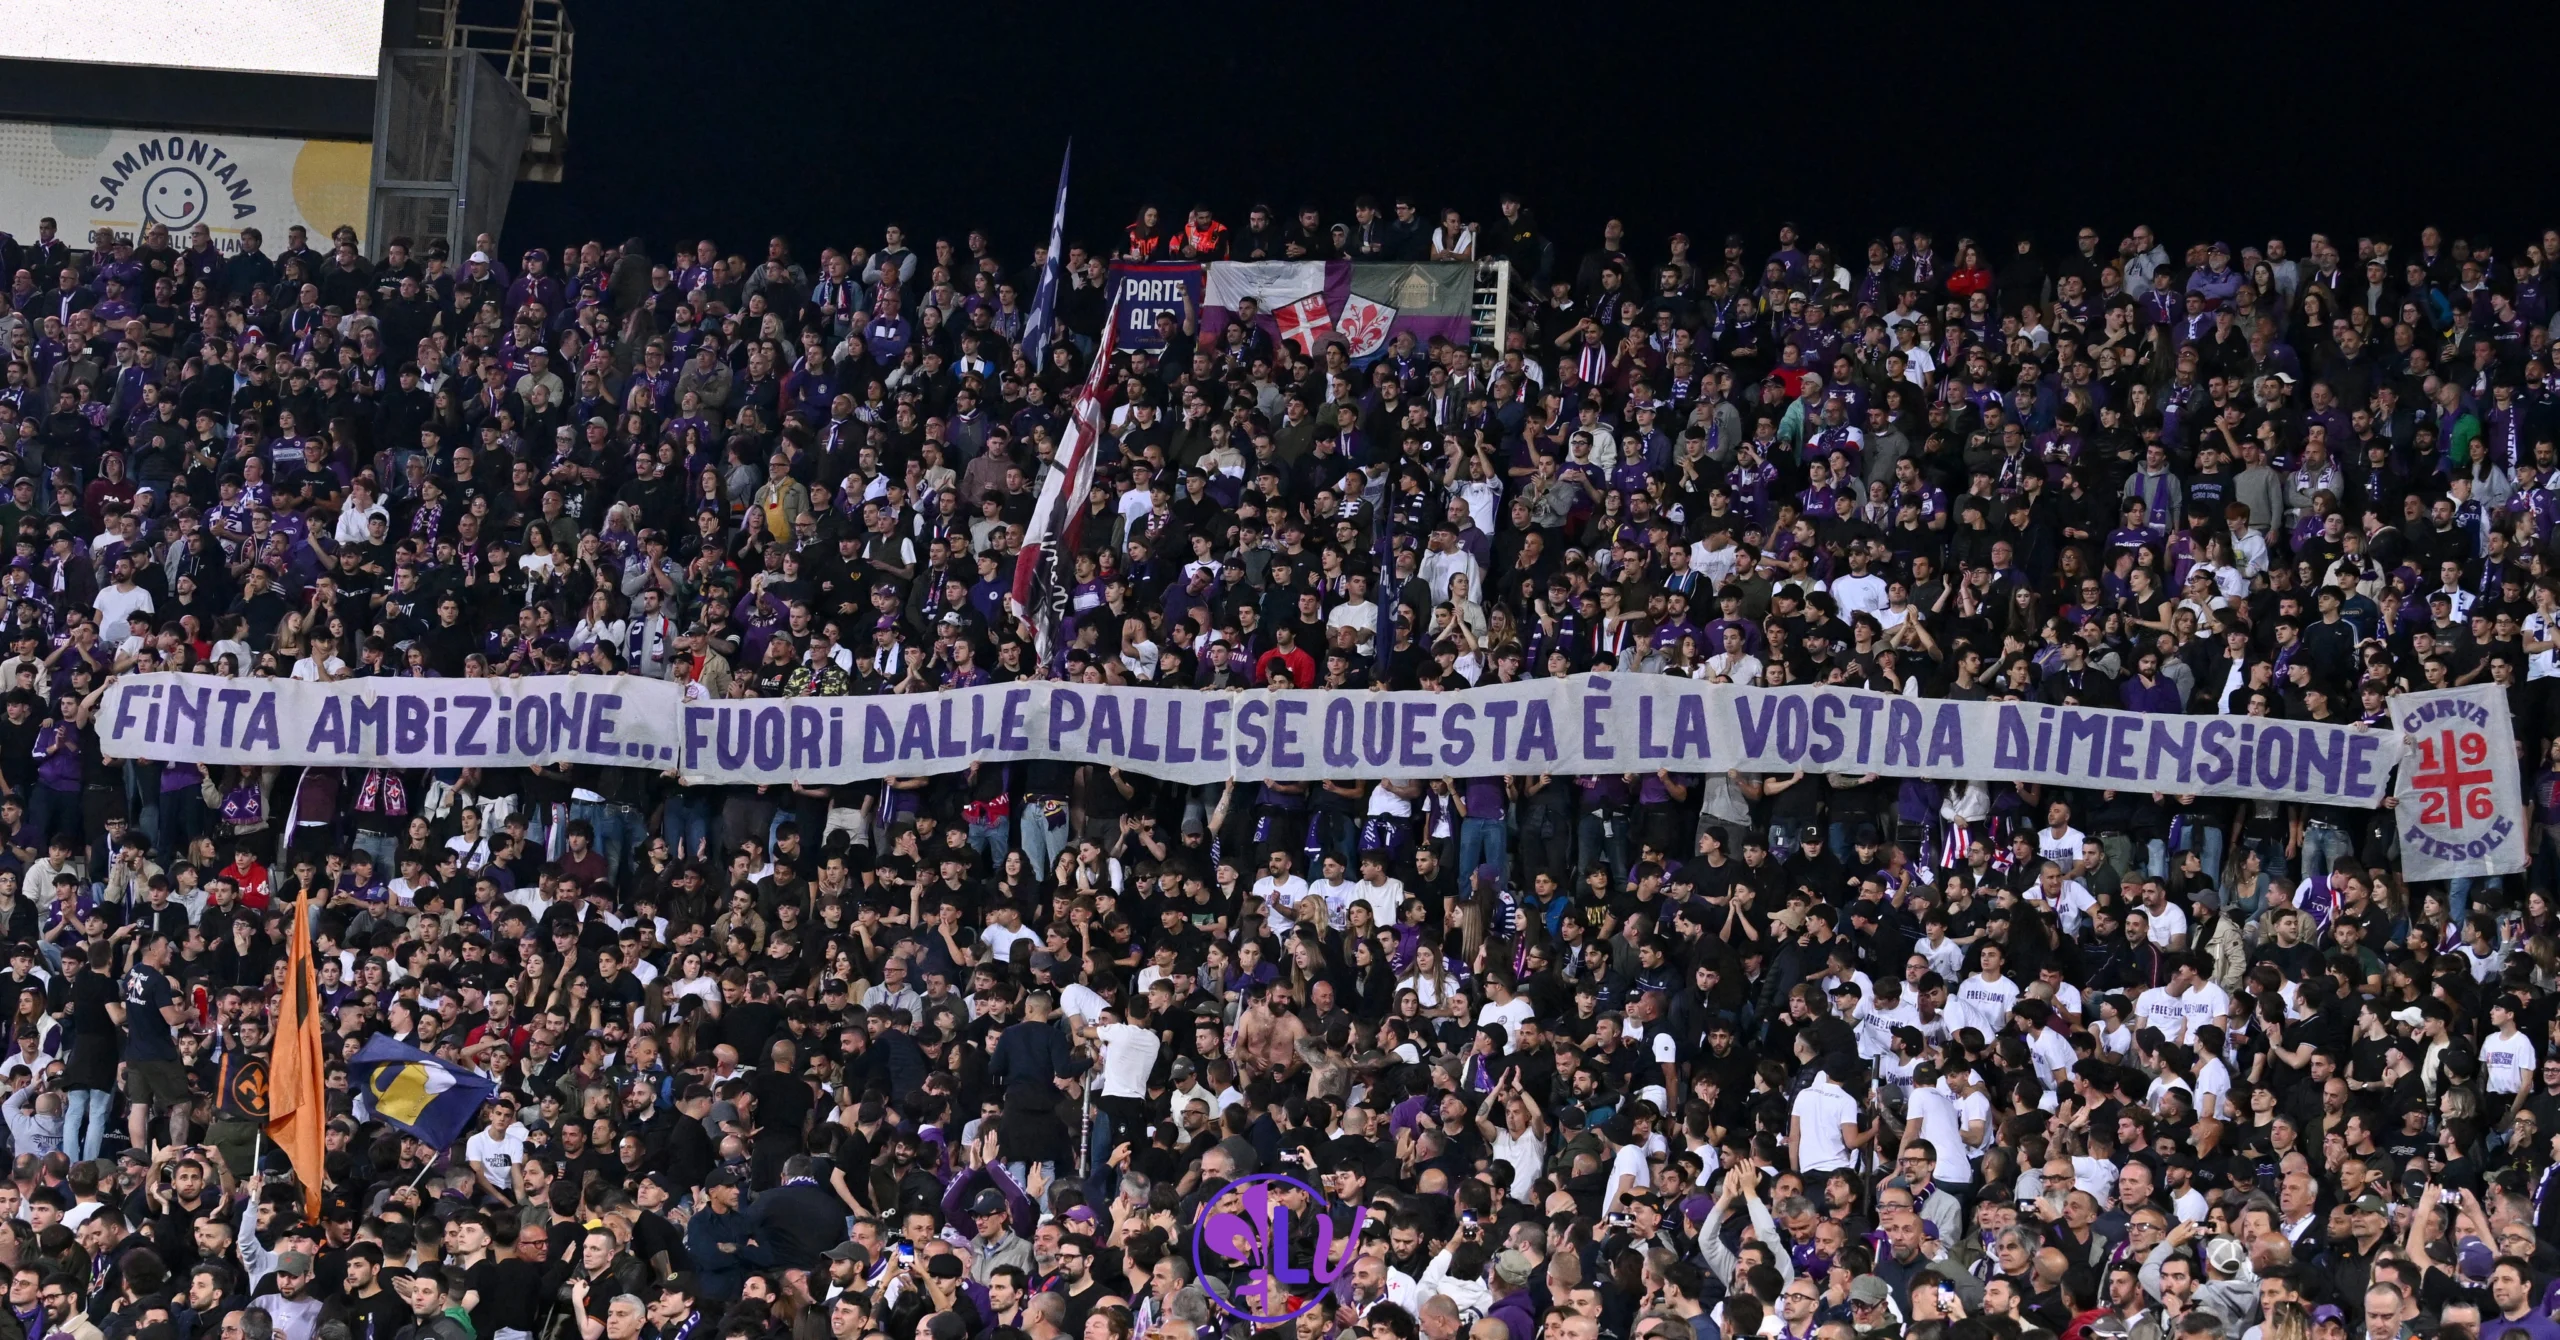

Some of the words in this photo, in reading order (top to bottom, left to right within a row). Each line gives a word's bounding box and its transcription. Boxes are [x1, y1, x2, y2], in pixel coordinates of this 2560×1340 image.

[91, 137, 256, 220] SAMMONTANA
[1126, 279, 1184, 302] PARTE
[863, 689, 1030, 763] DALLE
[1049, 689, 1229, 763] PALLE
[1237, 699, 1307, 767] SE
[1324, 698, 1557, 767] QUESTA
[1583, 677, 1613, 760] È
[1639, 695, 1711, 759] LA
[1736, 695, 1963, 767] VOSTRA
[2403, 699, 2490, 733] CURVA
[2404, 814, 2514, 861] FIESOLE
[1966, 990, 1982, 1000] FREE
[1987, 992, 2004, 1004] LIONS
[2150, 1004, 2168, 1016] FREE
[1866, 1013, 1881, 1027] FREE
